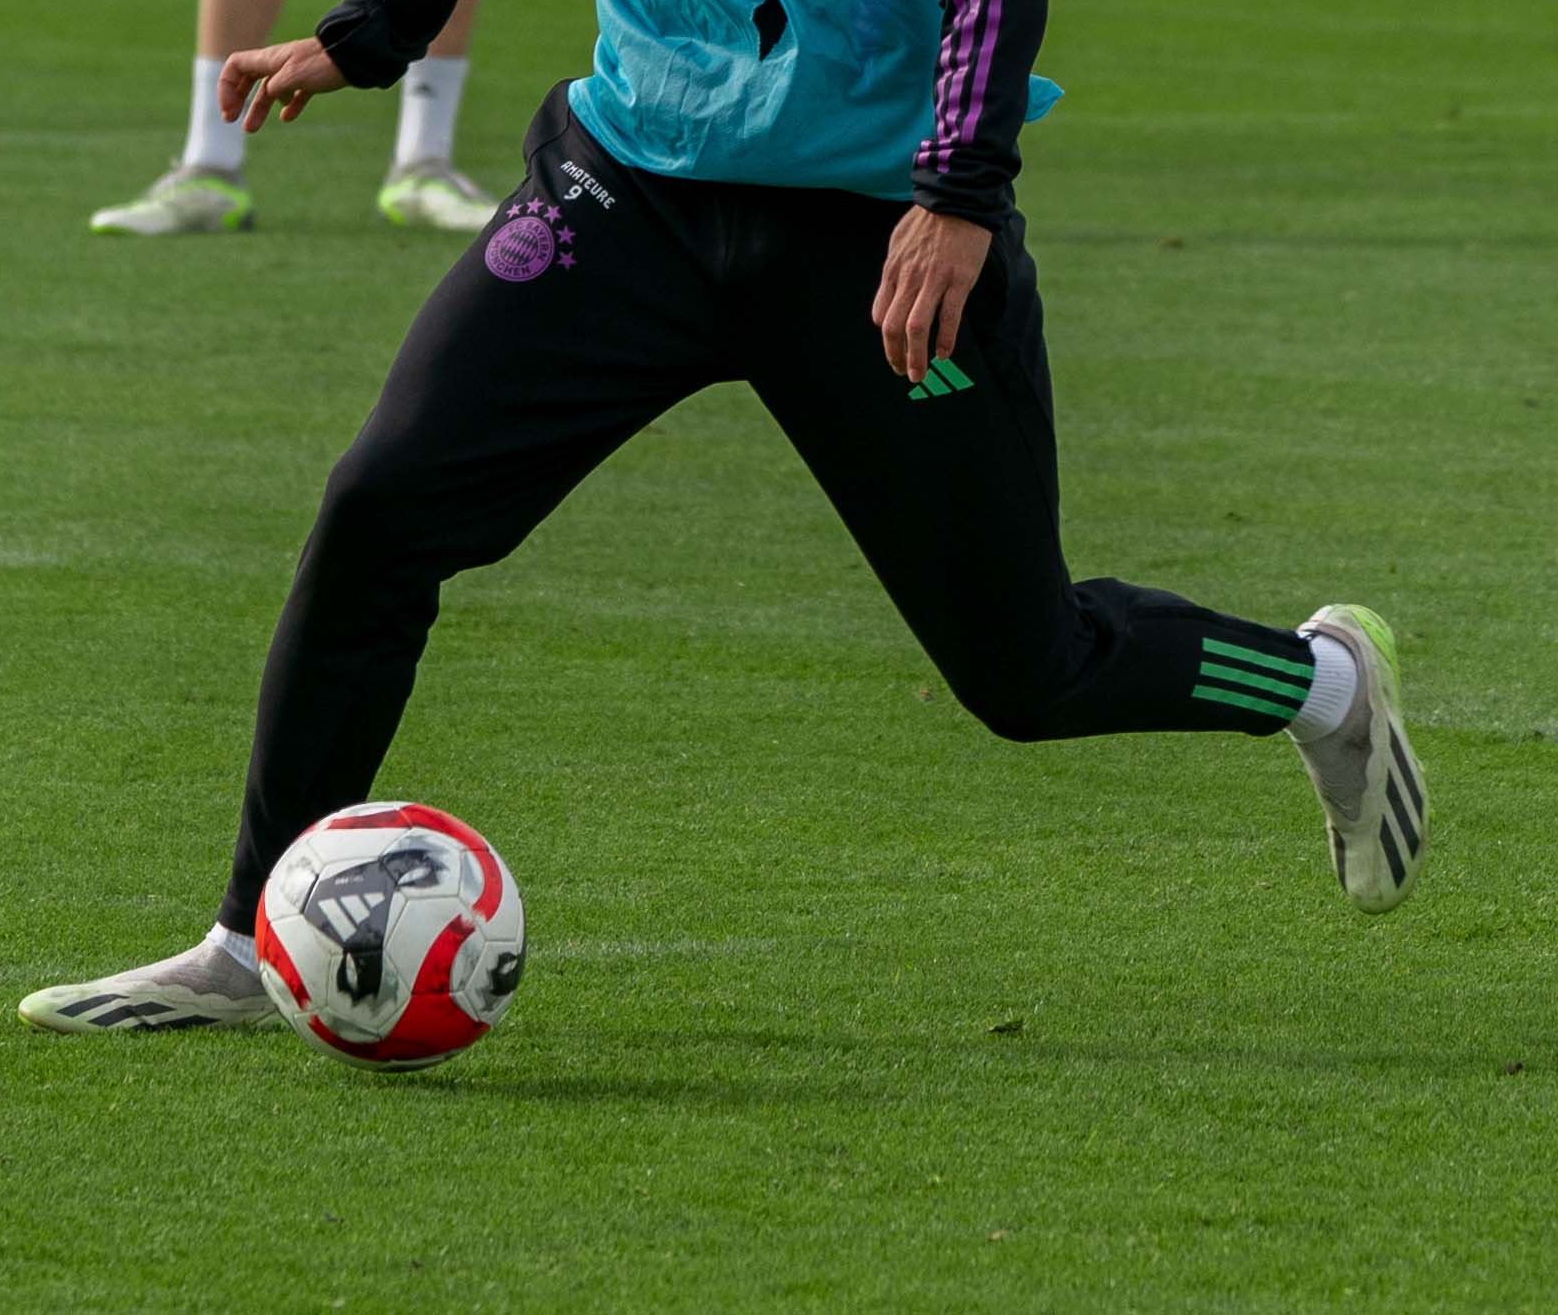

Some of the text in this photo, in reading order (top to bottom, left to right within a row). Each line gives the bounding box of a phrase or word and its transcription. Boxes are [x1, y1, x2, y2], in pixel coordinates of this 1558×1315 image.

[560, 160, 616, 210] AMATEURE
[563, 185, 583, 200] 9
[526, 221, 548, 262] BAYERN
